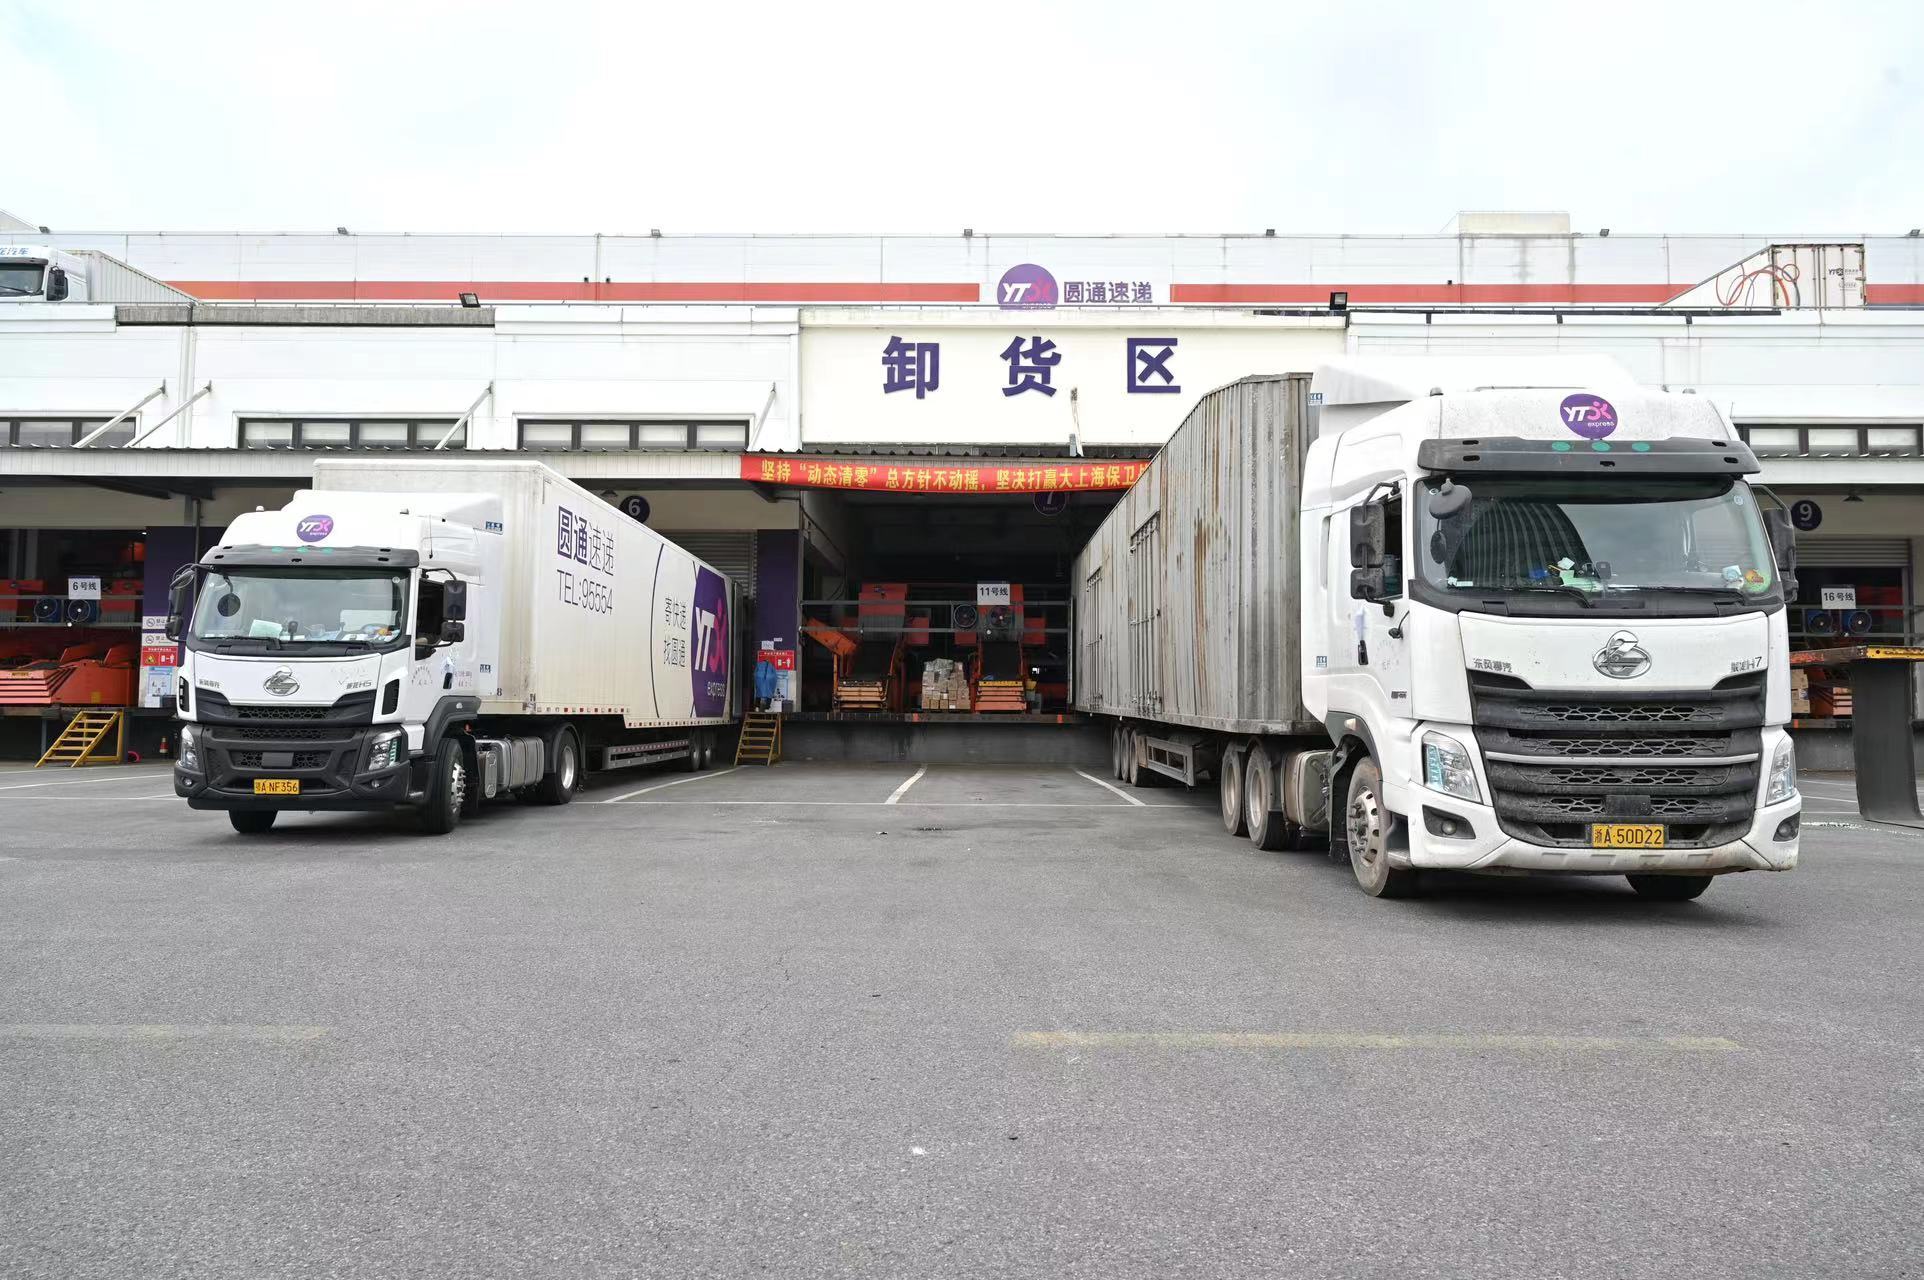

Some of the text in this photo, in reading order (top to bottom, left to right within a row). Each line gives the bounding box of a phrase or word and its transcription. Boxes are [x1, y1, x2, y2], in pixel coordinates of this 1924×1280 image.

[1063, 281, 1153, 303] 圆通速递
[882, 336, 1181, 399] 卸货区
[629, 499, 640, 516] 6
[1800, 504, 1812, 521] 9
[558, 505, 614, 576] 圆通速递
[73, 581, 97, 591] 6号线
[557, 569, 613, 614] TEL:95554
[980, 587, 1008, 596] 11号线
[1824, 592, 1854, 602] 16号线
